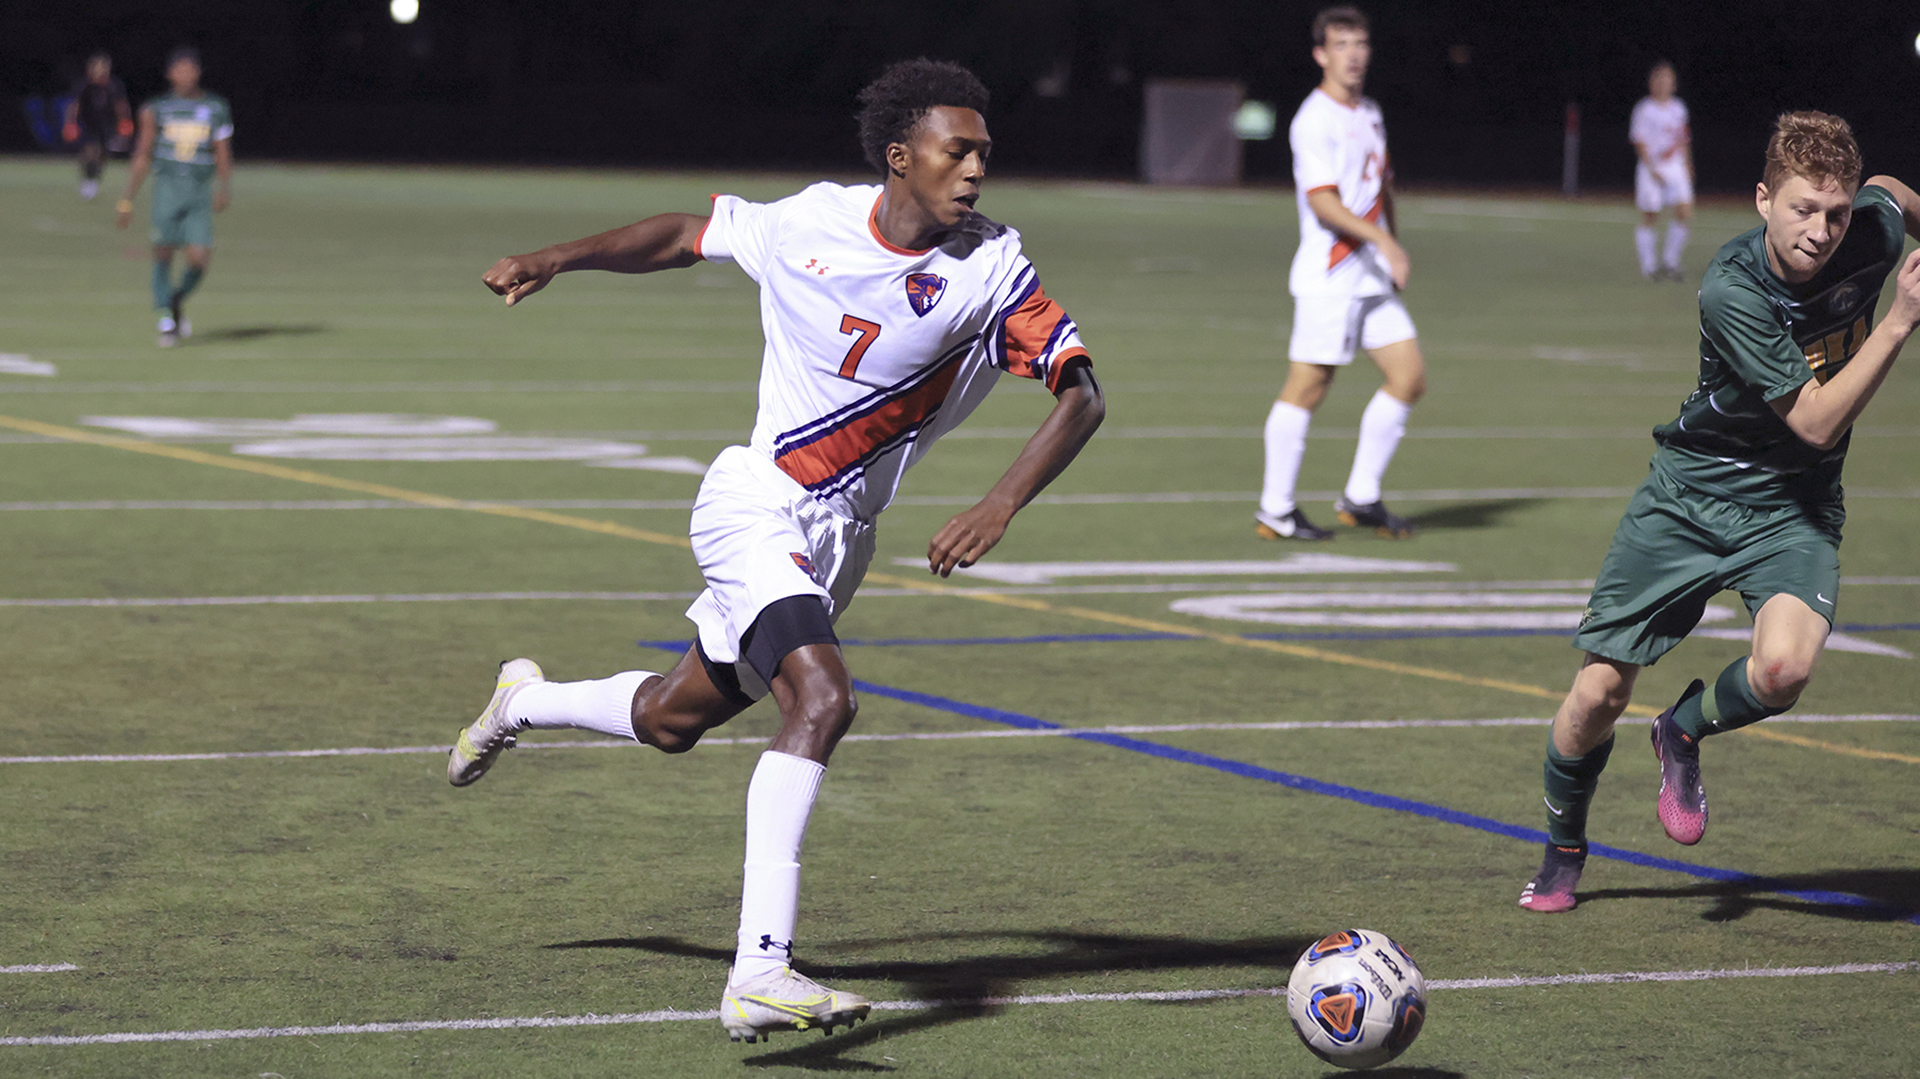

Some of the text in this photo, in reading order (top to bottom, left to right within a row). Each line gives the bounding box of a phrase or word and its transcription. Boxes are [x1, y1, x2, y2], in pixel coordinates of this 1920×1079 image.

[838, 313, 882, 379] 7
[1359, 958, 1392, 1000] Wilson
[1375, 949, 1406, 981] NCAA
